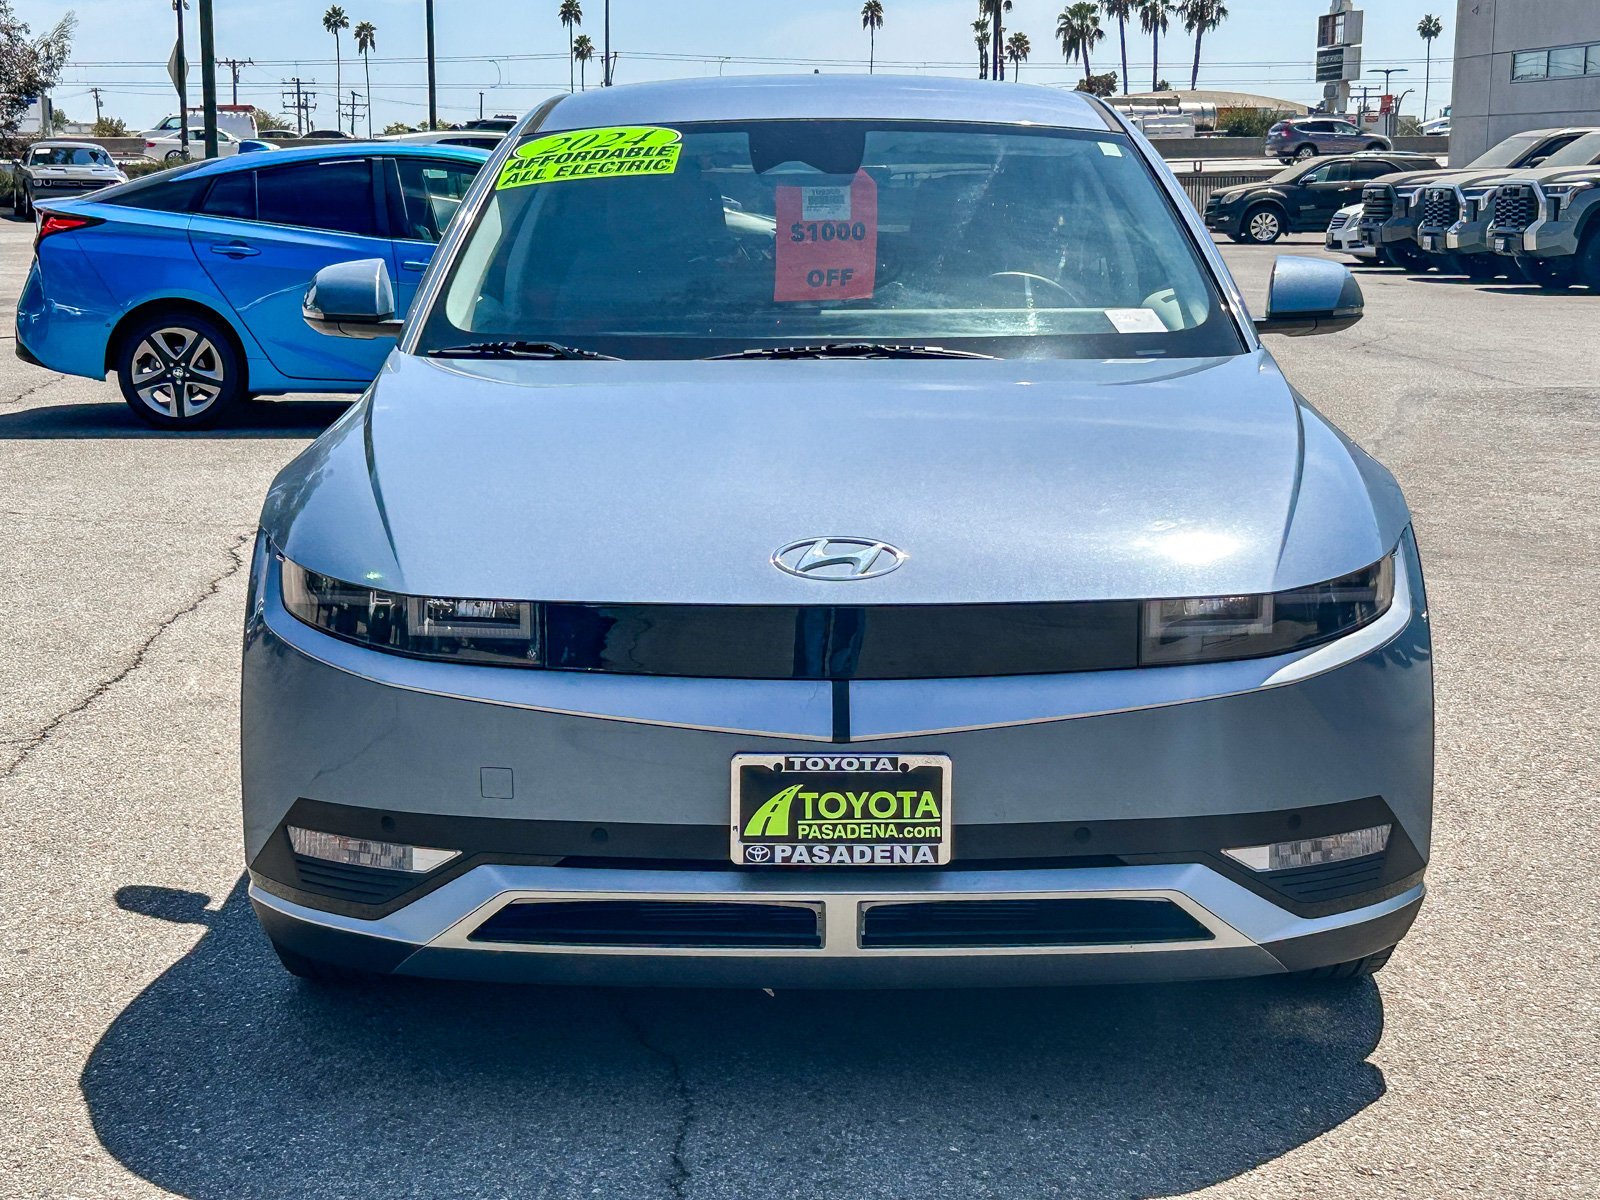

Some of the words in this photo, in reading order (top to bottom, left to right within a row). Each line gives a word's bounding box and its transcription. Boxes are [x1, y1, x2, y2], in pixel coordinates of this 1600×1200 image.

[539, 129, 657, 153] 2024
[506, 145, 676, 172] AFFORDABLE
[501, 167, 546, 186] ALL
[553, 158, 673, 177] ELECTRIC
[790, 221, 866, 242] $1000
[806, 268, 854, 288] OFF
[788, 757, 894, 771] TOYOTA
[798, 790, 940, 819] TOYOTA
[798, 823, 941, 839] PASADENA.com
[774, 845, 935, 863] PASADENA
